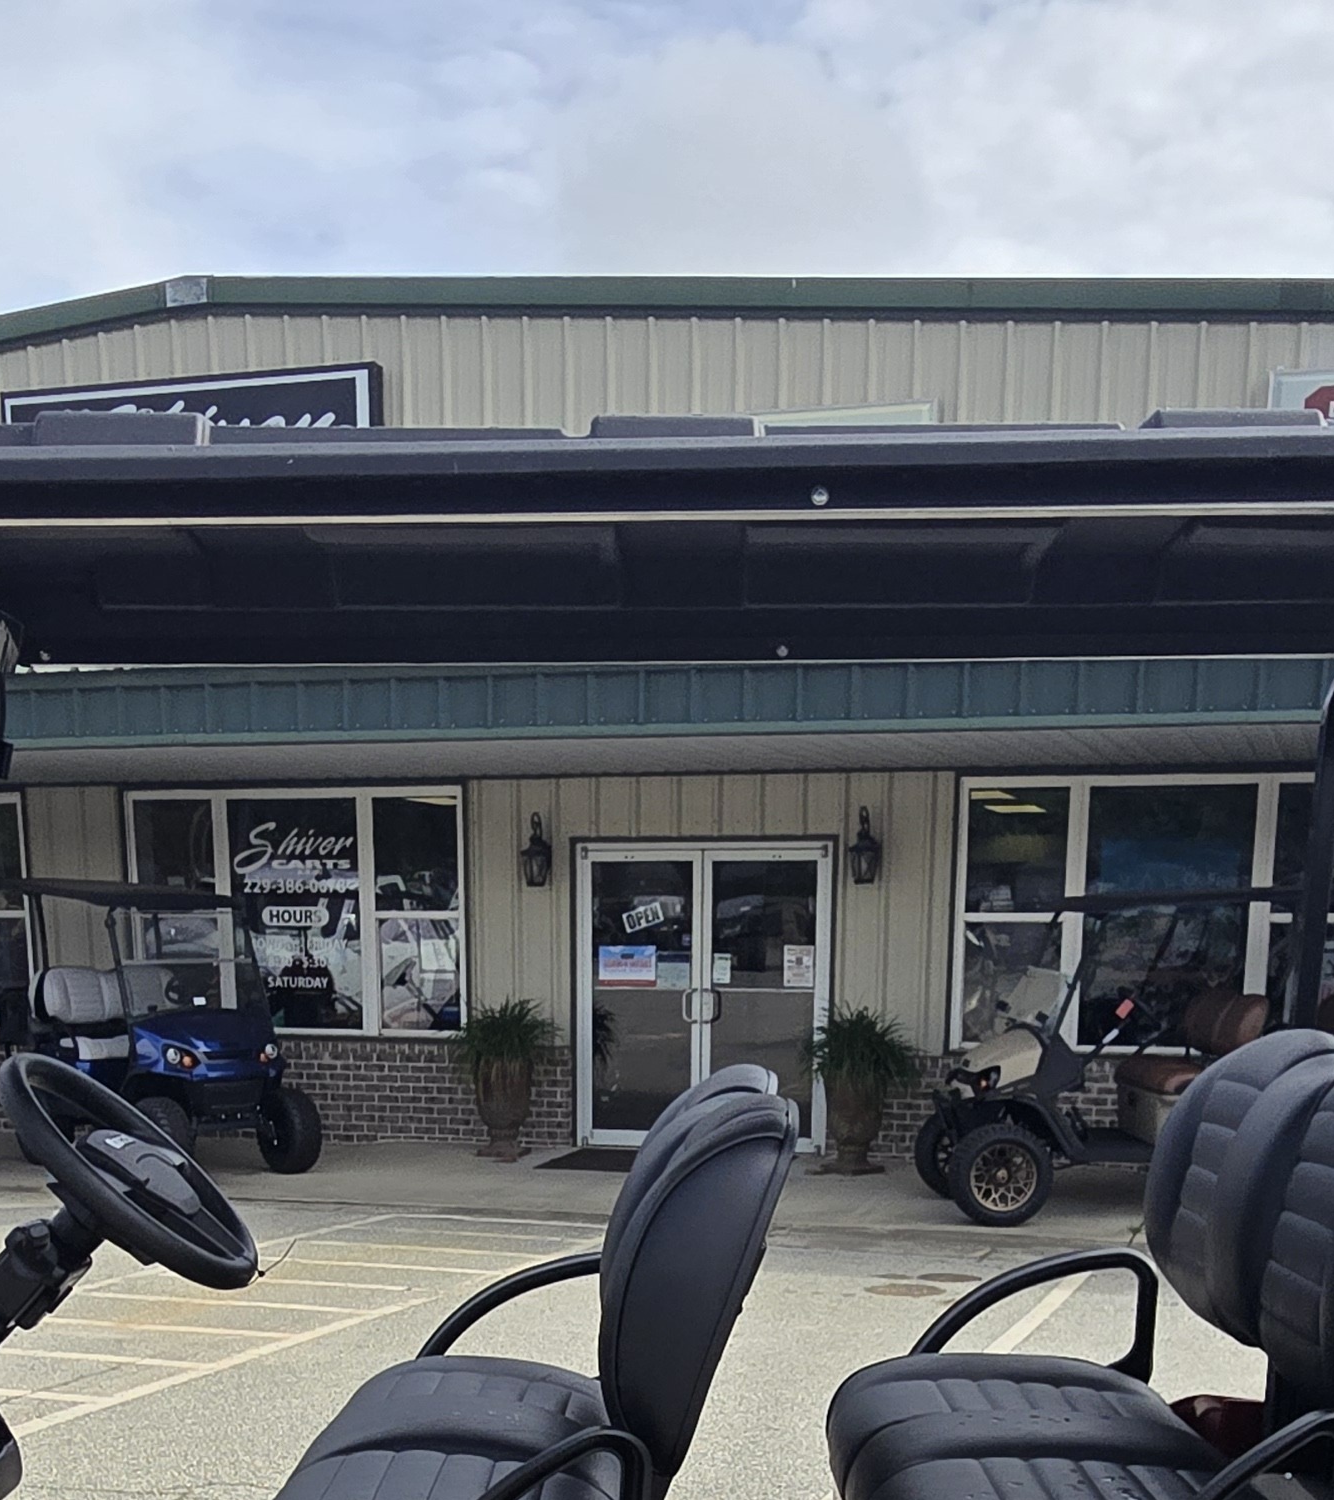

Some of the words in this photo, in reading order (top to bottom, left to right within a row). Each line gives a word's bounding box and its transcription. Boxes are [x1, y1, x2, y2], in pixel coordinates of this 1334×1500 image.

[233, 821, 354, 874] Shiver
[271, 859, 351, 870] CARTS
[269, 909, 323, 924] HOURS
[625, 905, 661, 930] OPEN
[267, 976, 329, 988] SATURDAY
